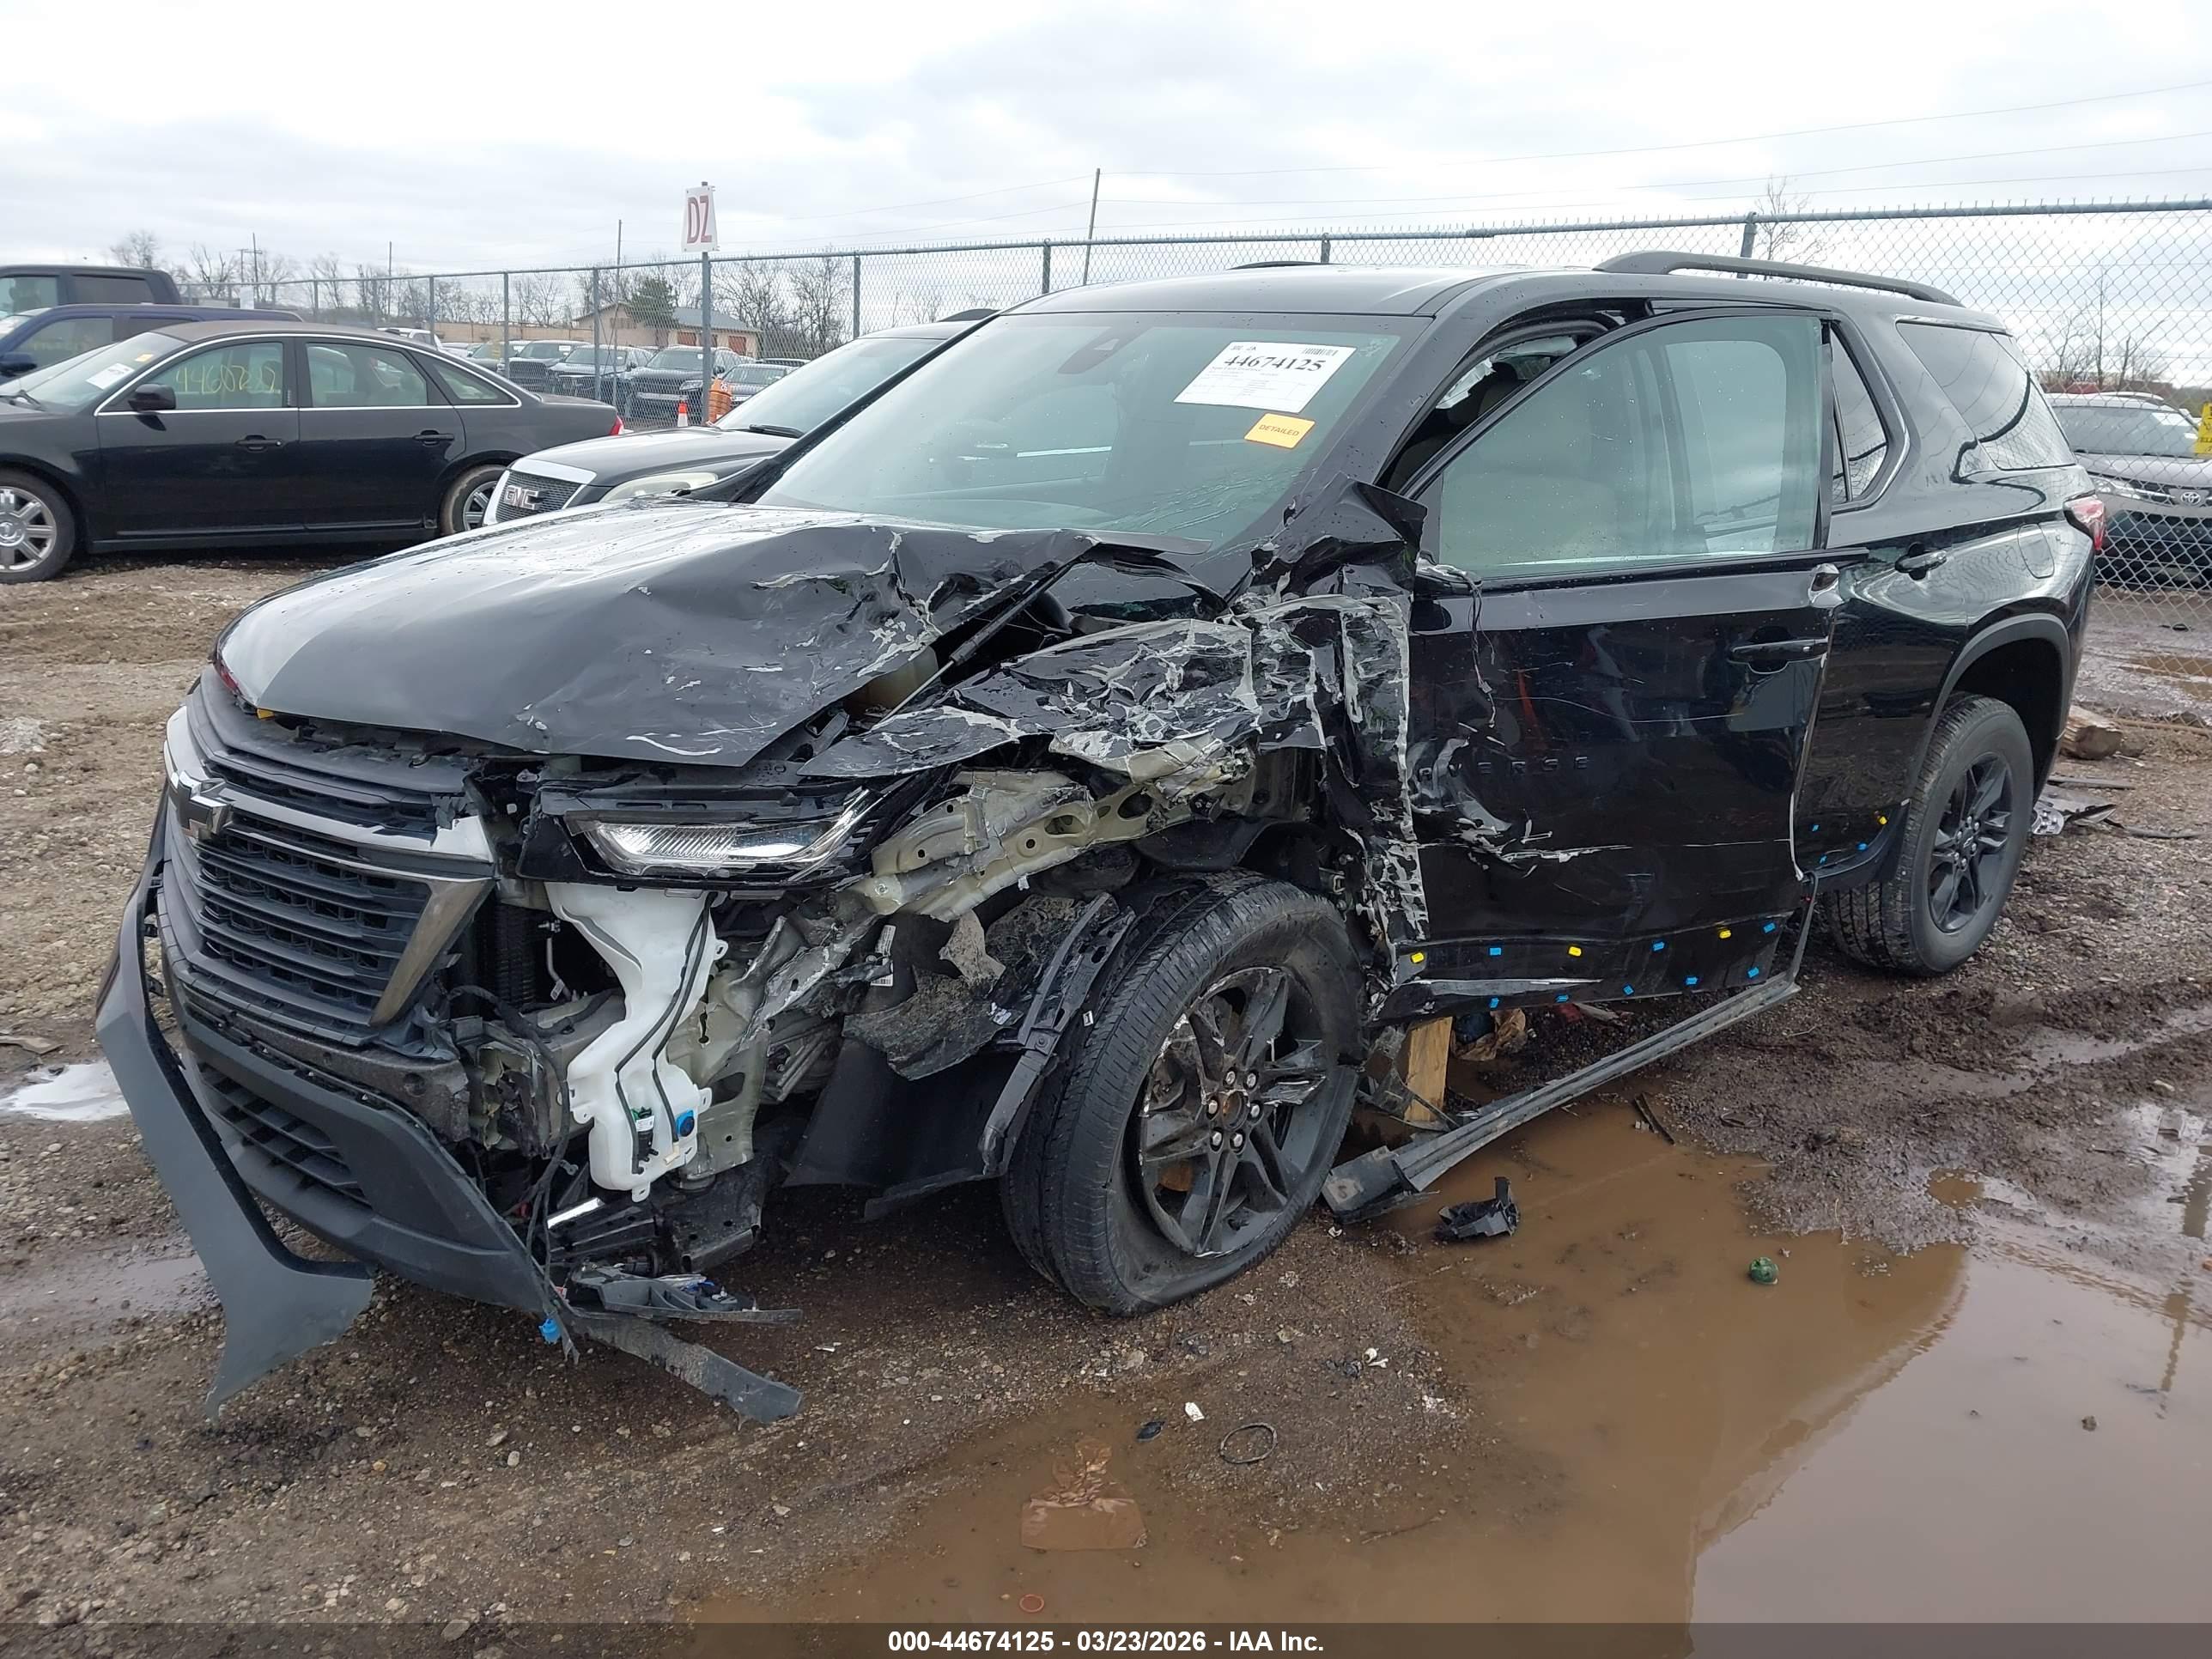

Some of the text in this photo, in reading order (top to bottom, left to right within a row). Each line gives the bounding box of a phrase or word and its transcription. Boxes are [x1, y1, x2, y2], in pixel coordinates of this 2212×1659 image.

[1224, 355, 1327, 372] 44674125
[1259, 424, 1300, 436] DETAILED
[504, 485, 539, 510] GMC
